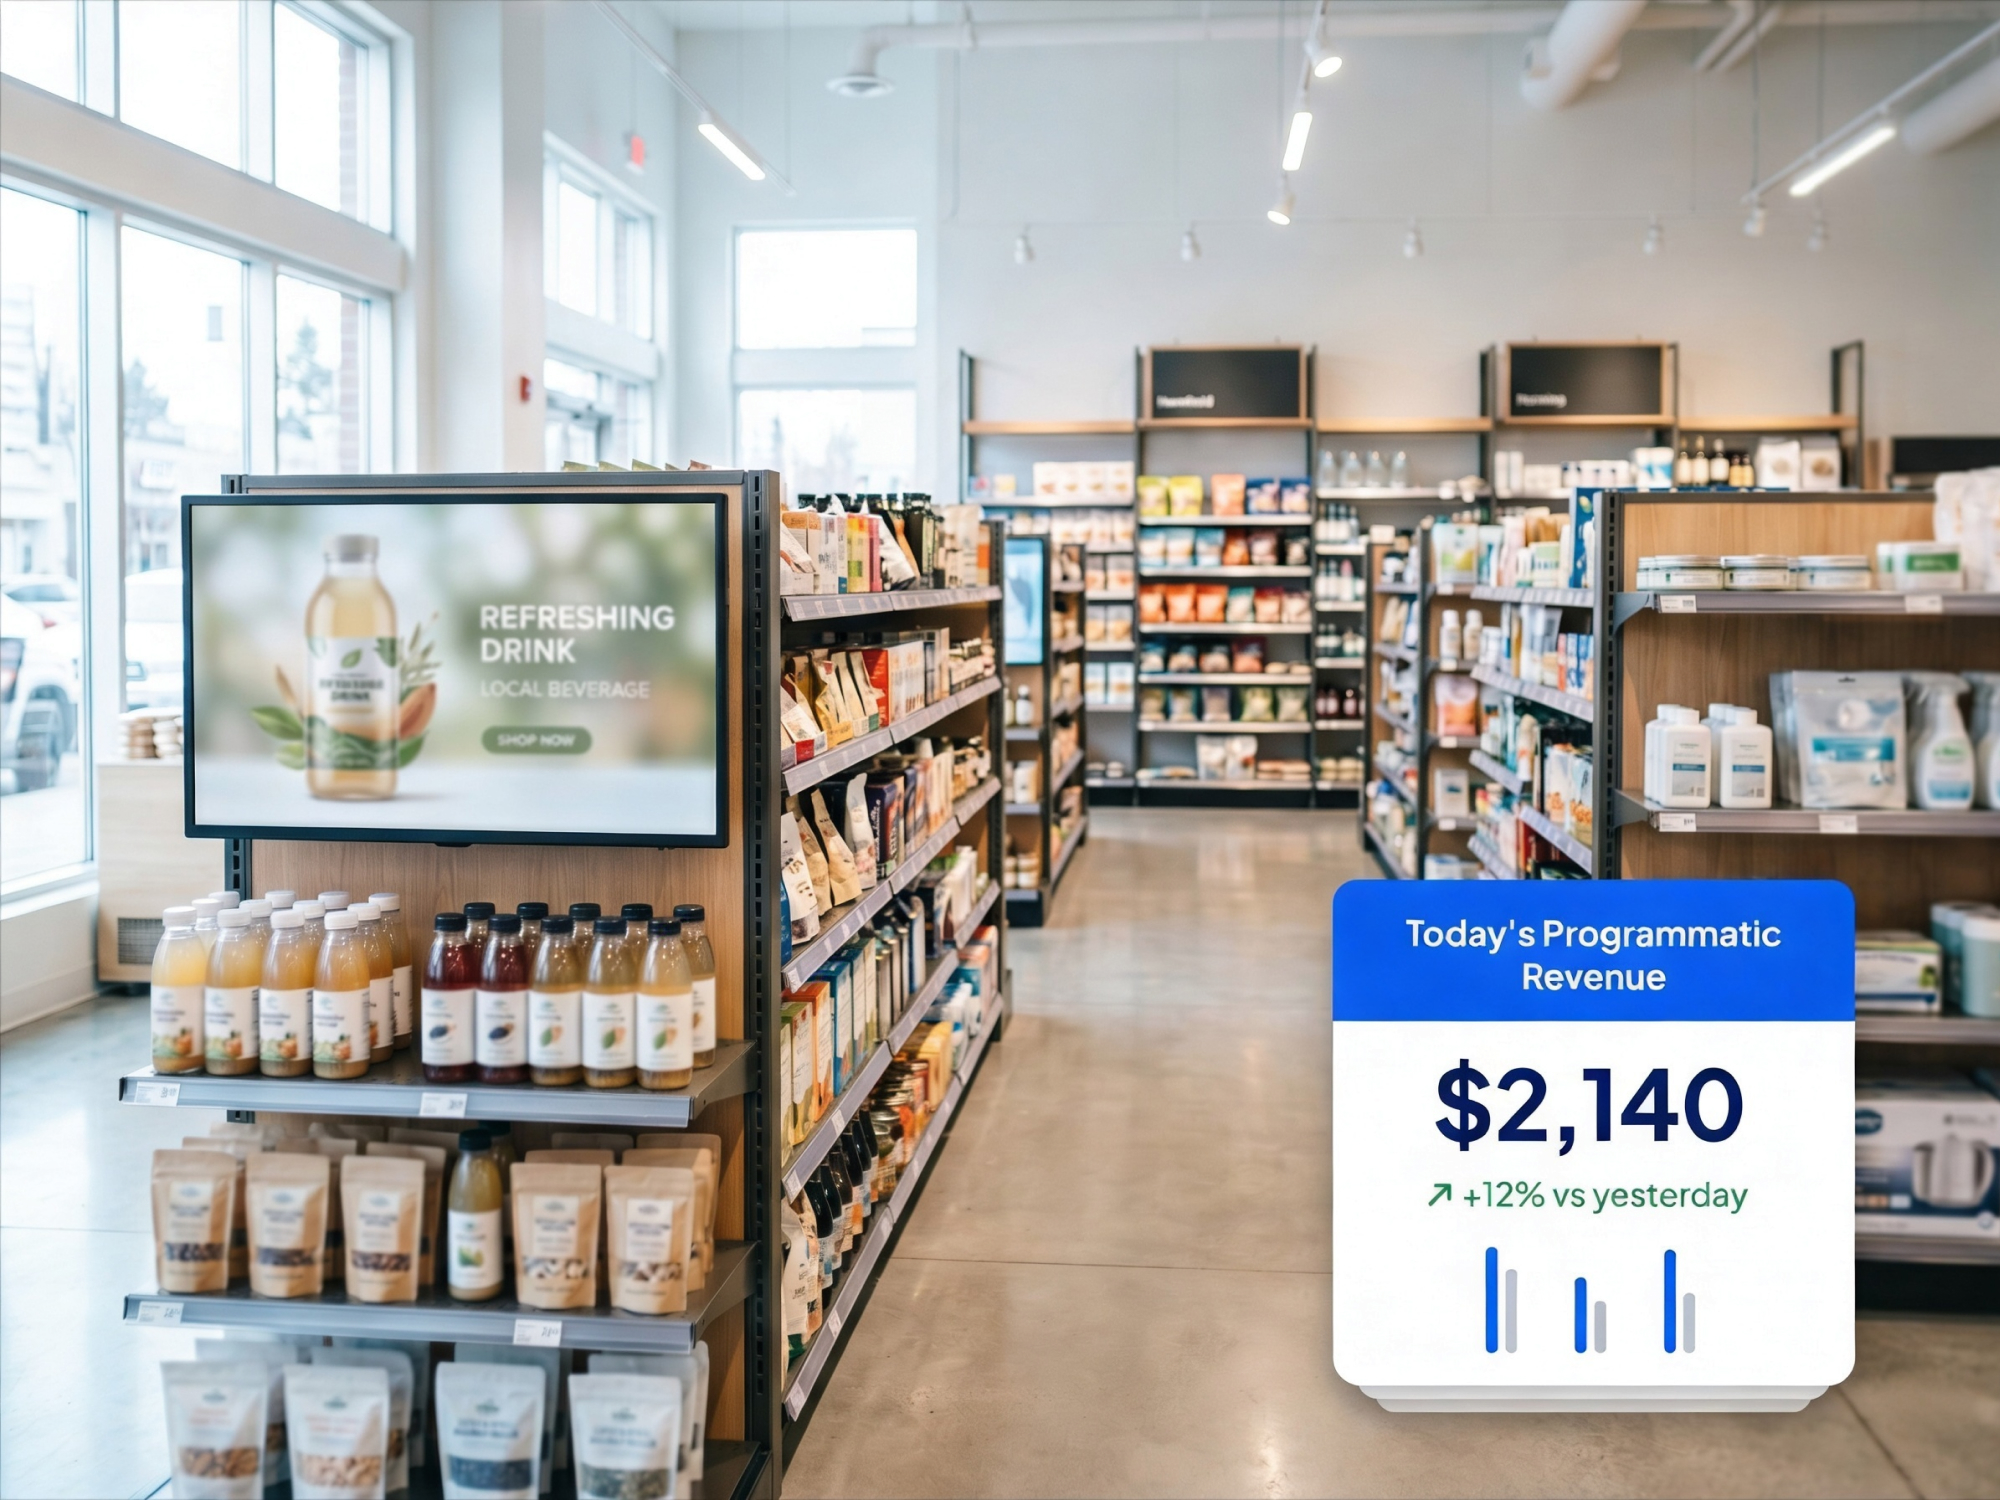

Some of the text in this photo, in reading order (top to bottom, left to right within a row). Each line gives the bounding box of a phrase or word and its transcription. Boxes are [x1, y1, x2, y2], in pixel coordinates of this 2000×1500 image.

[480, 605, 675, 631] REFRESHING
[480, 638, 576, 663] DRINK
[480, 680, 650, 699] LOCAL BEVERAGE
[497, 734, 576, 747] SHOP NOW
